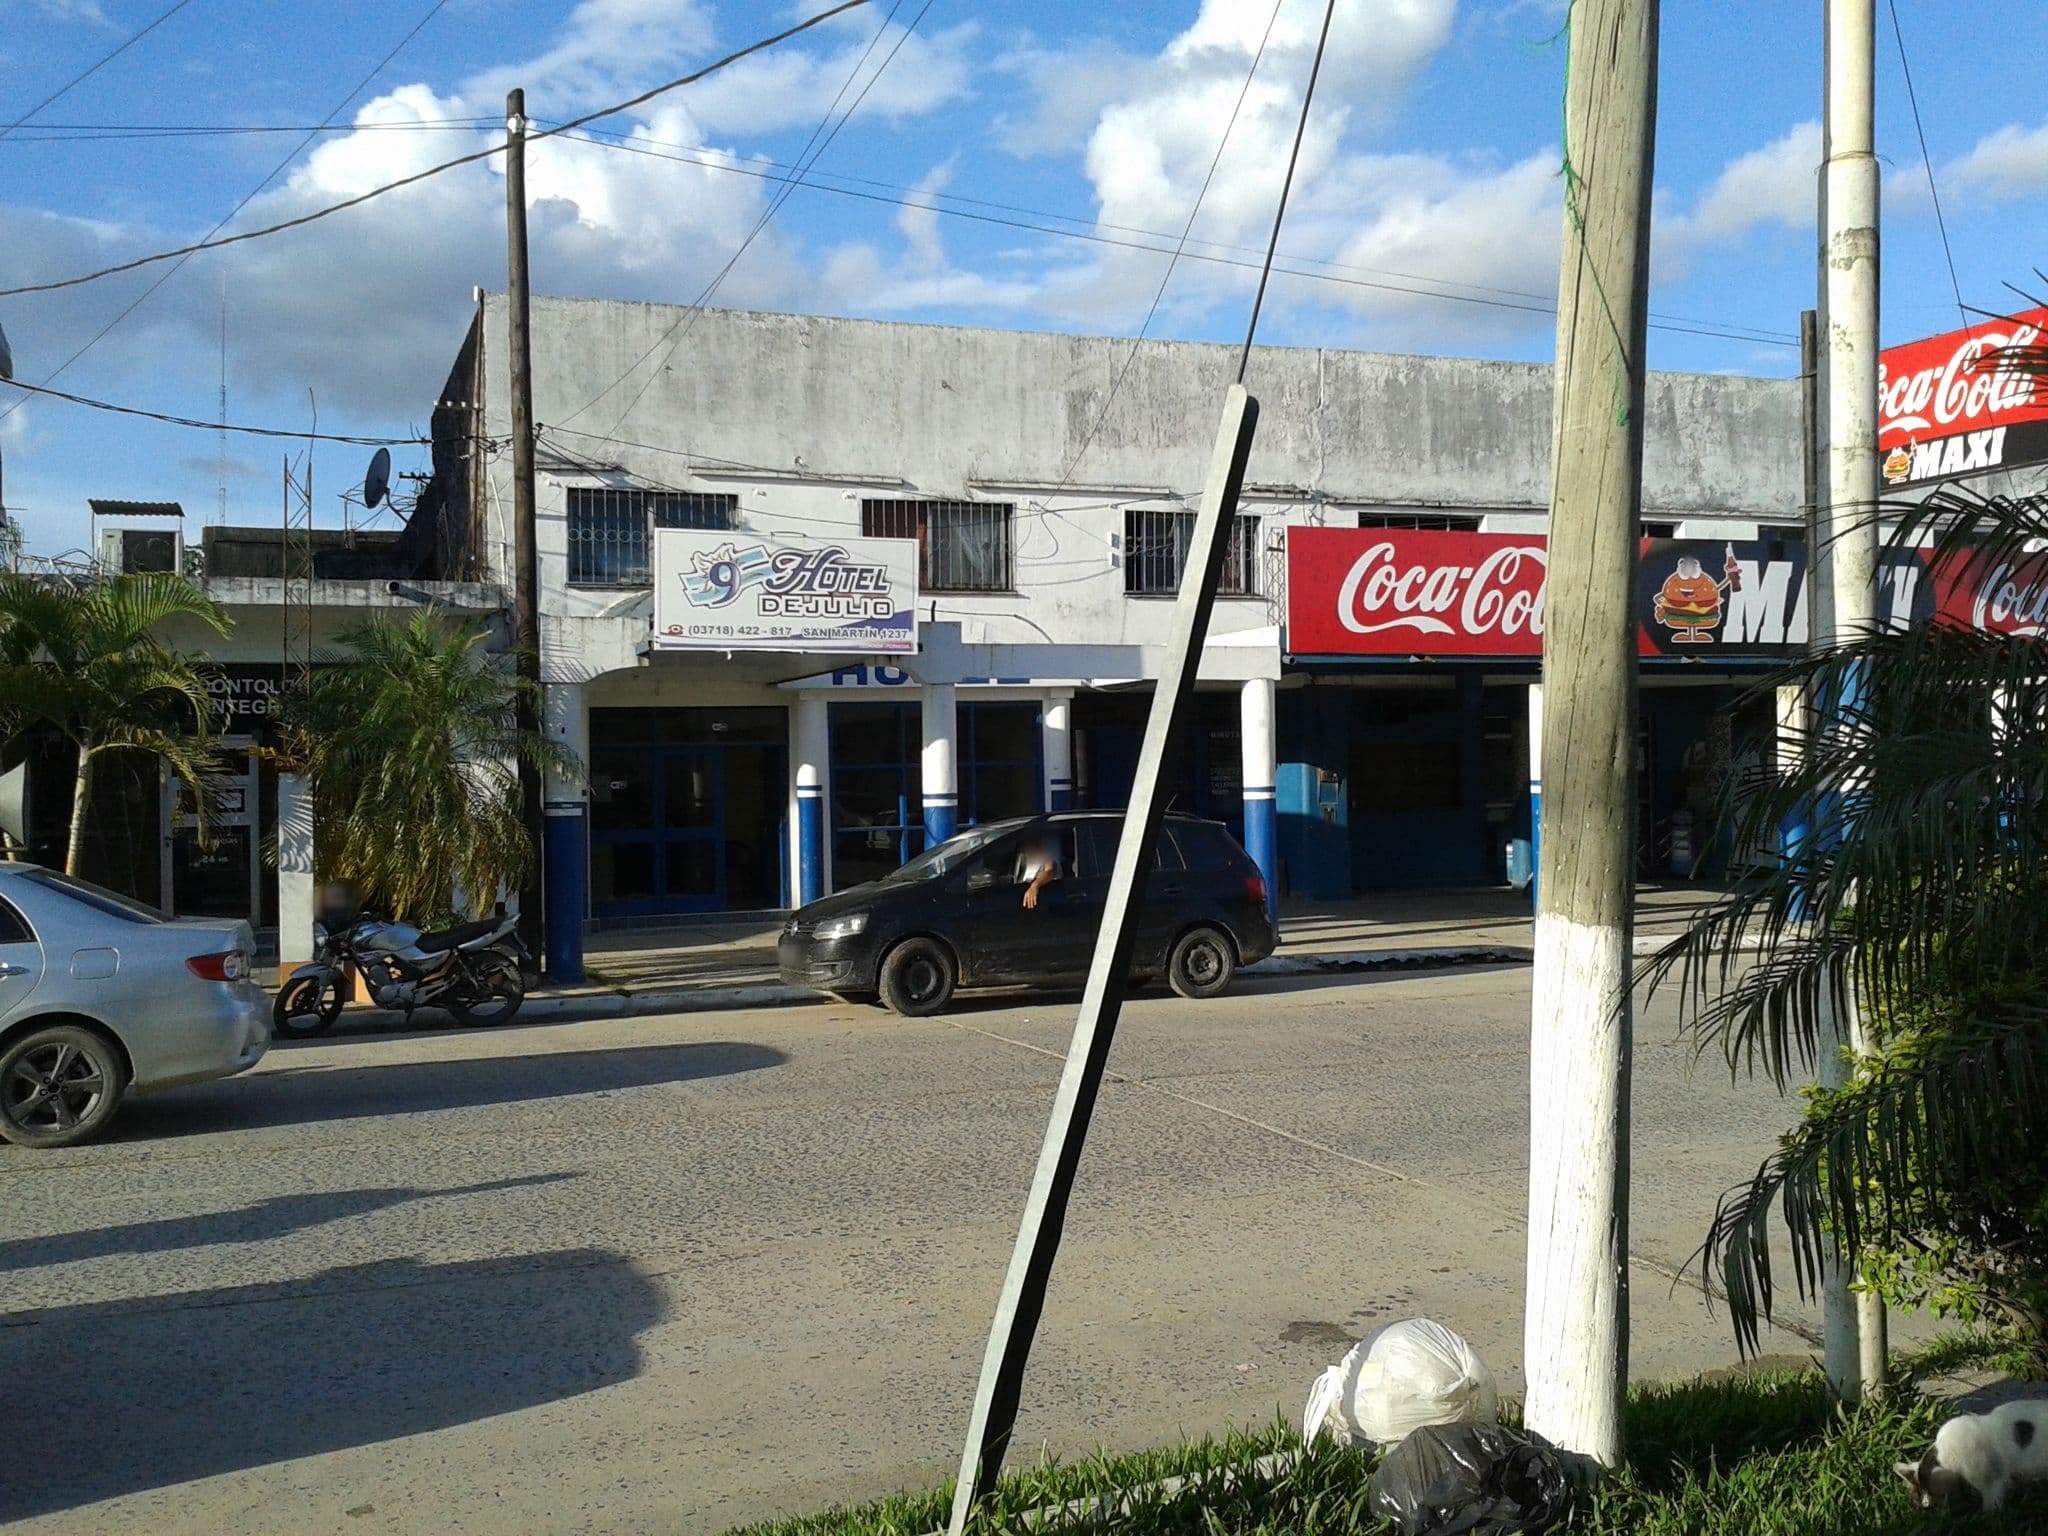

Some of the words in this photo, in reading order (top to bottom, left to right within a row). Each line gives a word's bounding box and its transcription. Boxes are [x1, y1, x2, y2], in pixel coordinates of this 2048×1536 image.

[1910, 426, 2007, 481] MAXI
[709, 561, 741, 606] 9
[688, 625, 734, 636] (03718)
[738, 626, 760, 635] 422
[771, 626, 792, 635] 817
[803, 628, 826, 637] SAN
